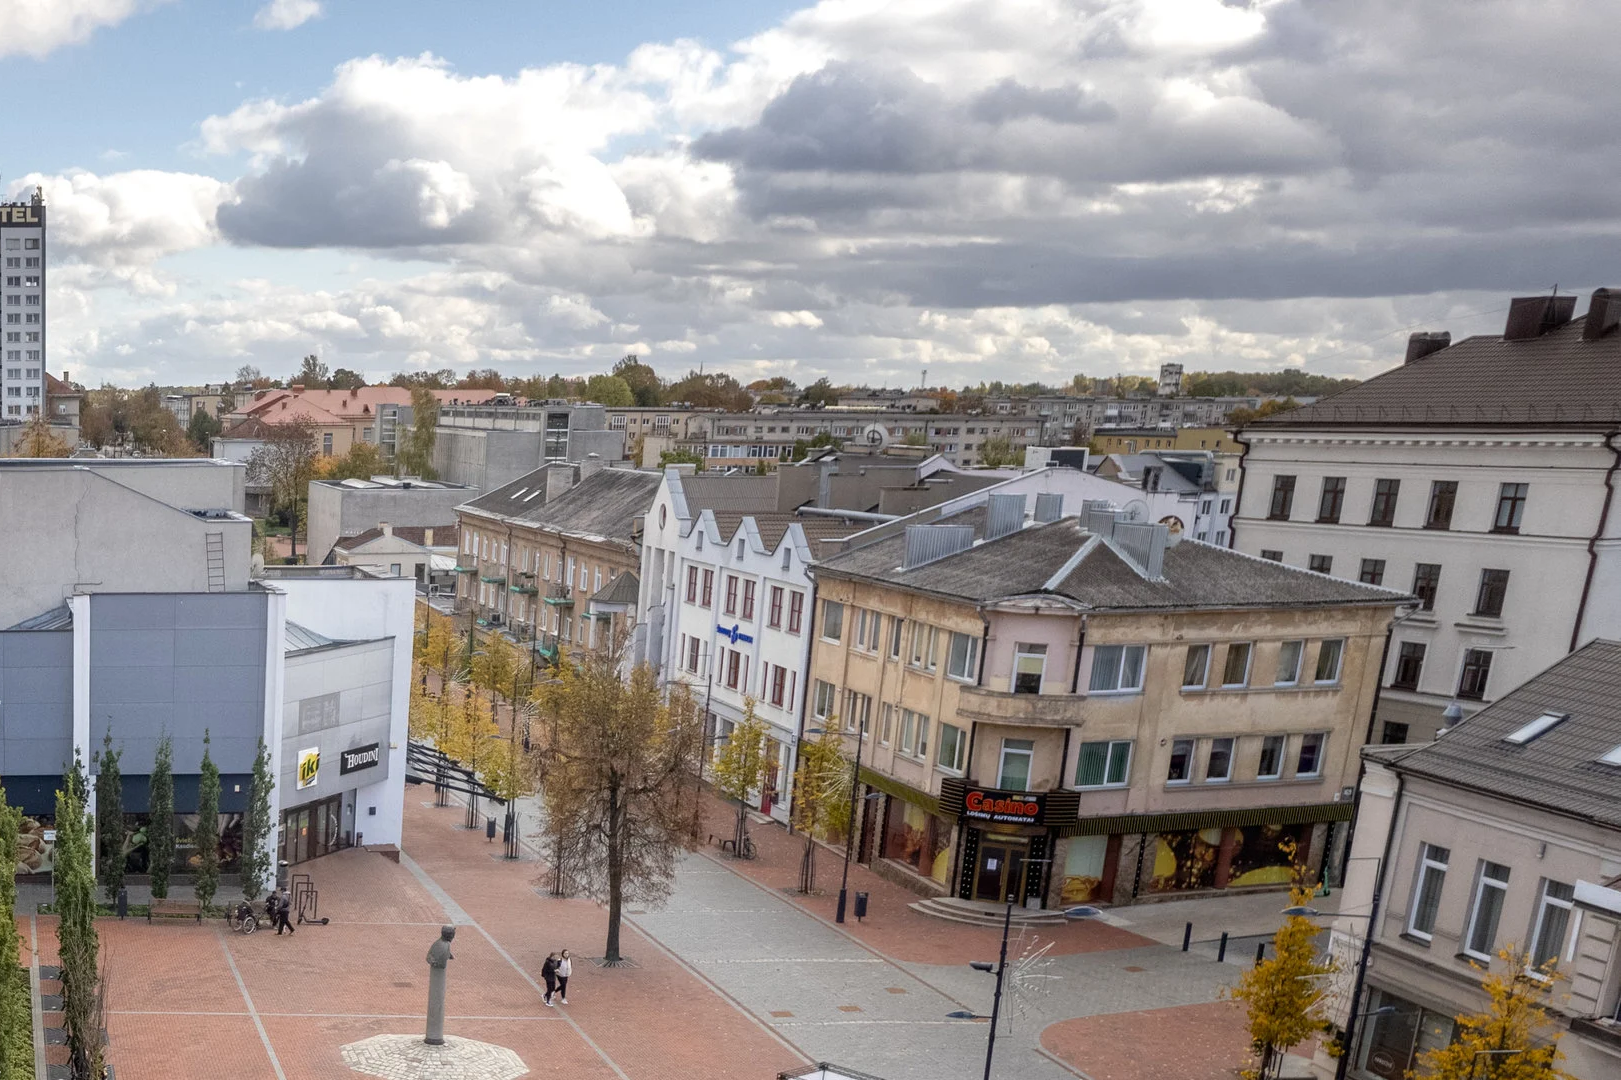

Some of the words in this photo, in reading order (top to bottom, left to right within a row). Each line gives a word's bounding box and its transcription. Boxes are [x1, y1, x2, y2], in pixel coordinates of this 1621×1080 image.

[301, 753, 320, 781] iki
[344, 748, 379, 769] HOUDINI
[966, 791, 1039, 816] Casino
[993, 814, 1035, 823] AUTOMATAI
